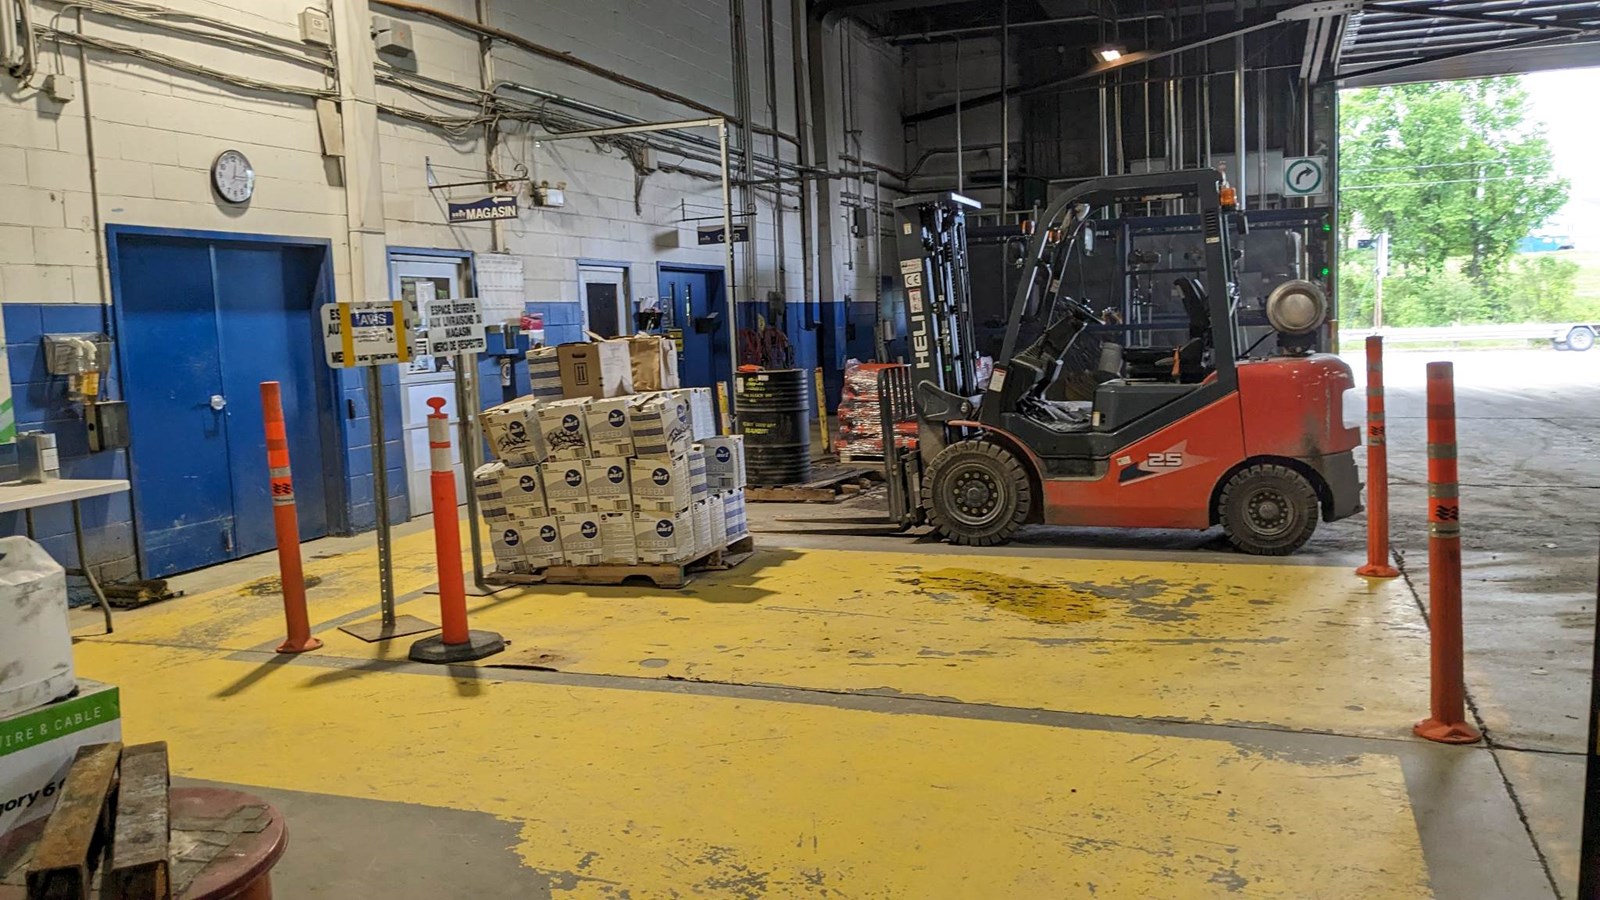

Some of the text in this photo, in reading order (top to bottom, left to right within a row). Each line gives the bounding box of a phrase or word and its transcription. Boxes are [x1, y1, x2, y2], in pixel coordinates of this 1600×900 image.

[466, 205, 516, 219] MAGASIN
[430, 304, 452, 316] ESPACE
[446, 326, 472, 338] MAGASIN
[433, 341, 449, 352] MERCI
[449, 340, 457, 351] DE
[911, 315, 930, 369] HELI
[1148, 452, 1182, 467] 25
[0, 706, 101, 748] IRE & CABLE
[43, 782, 56, 797] 6
